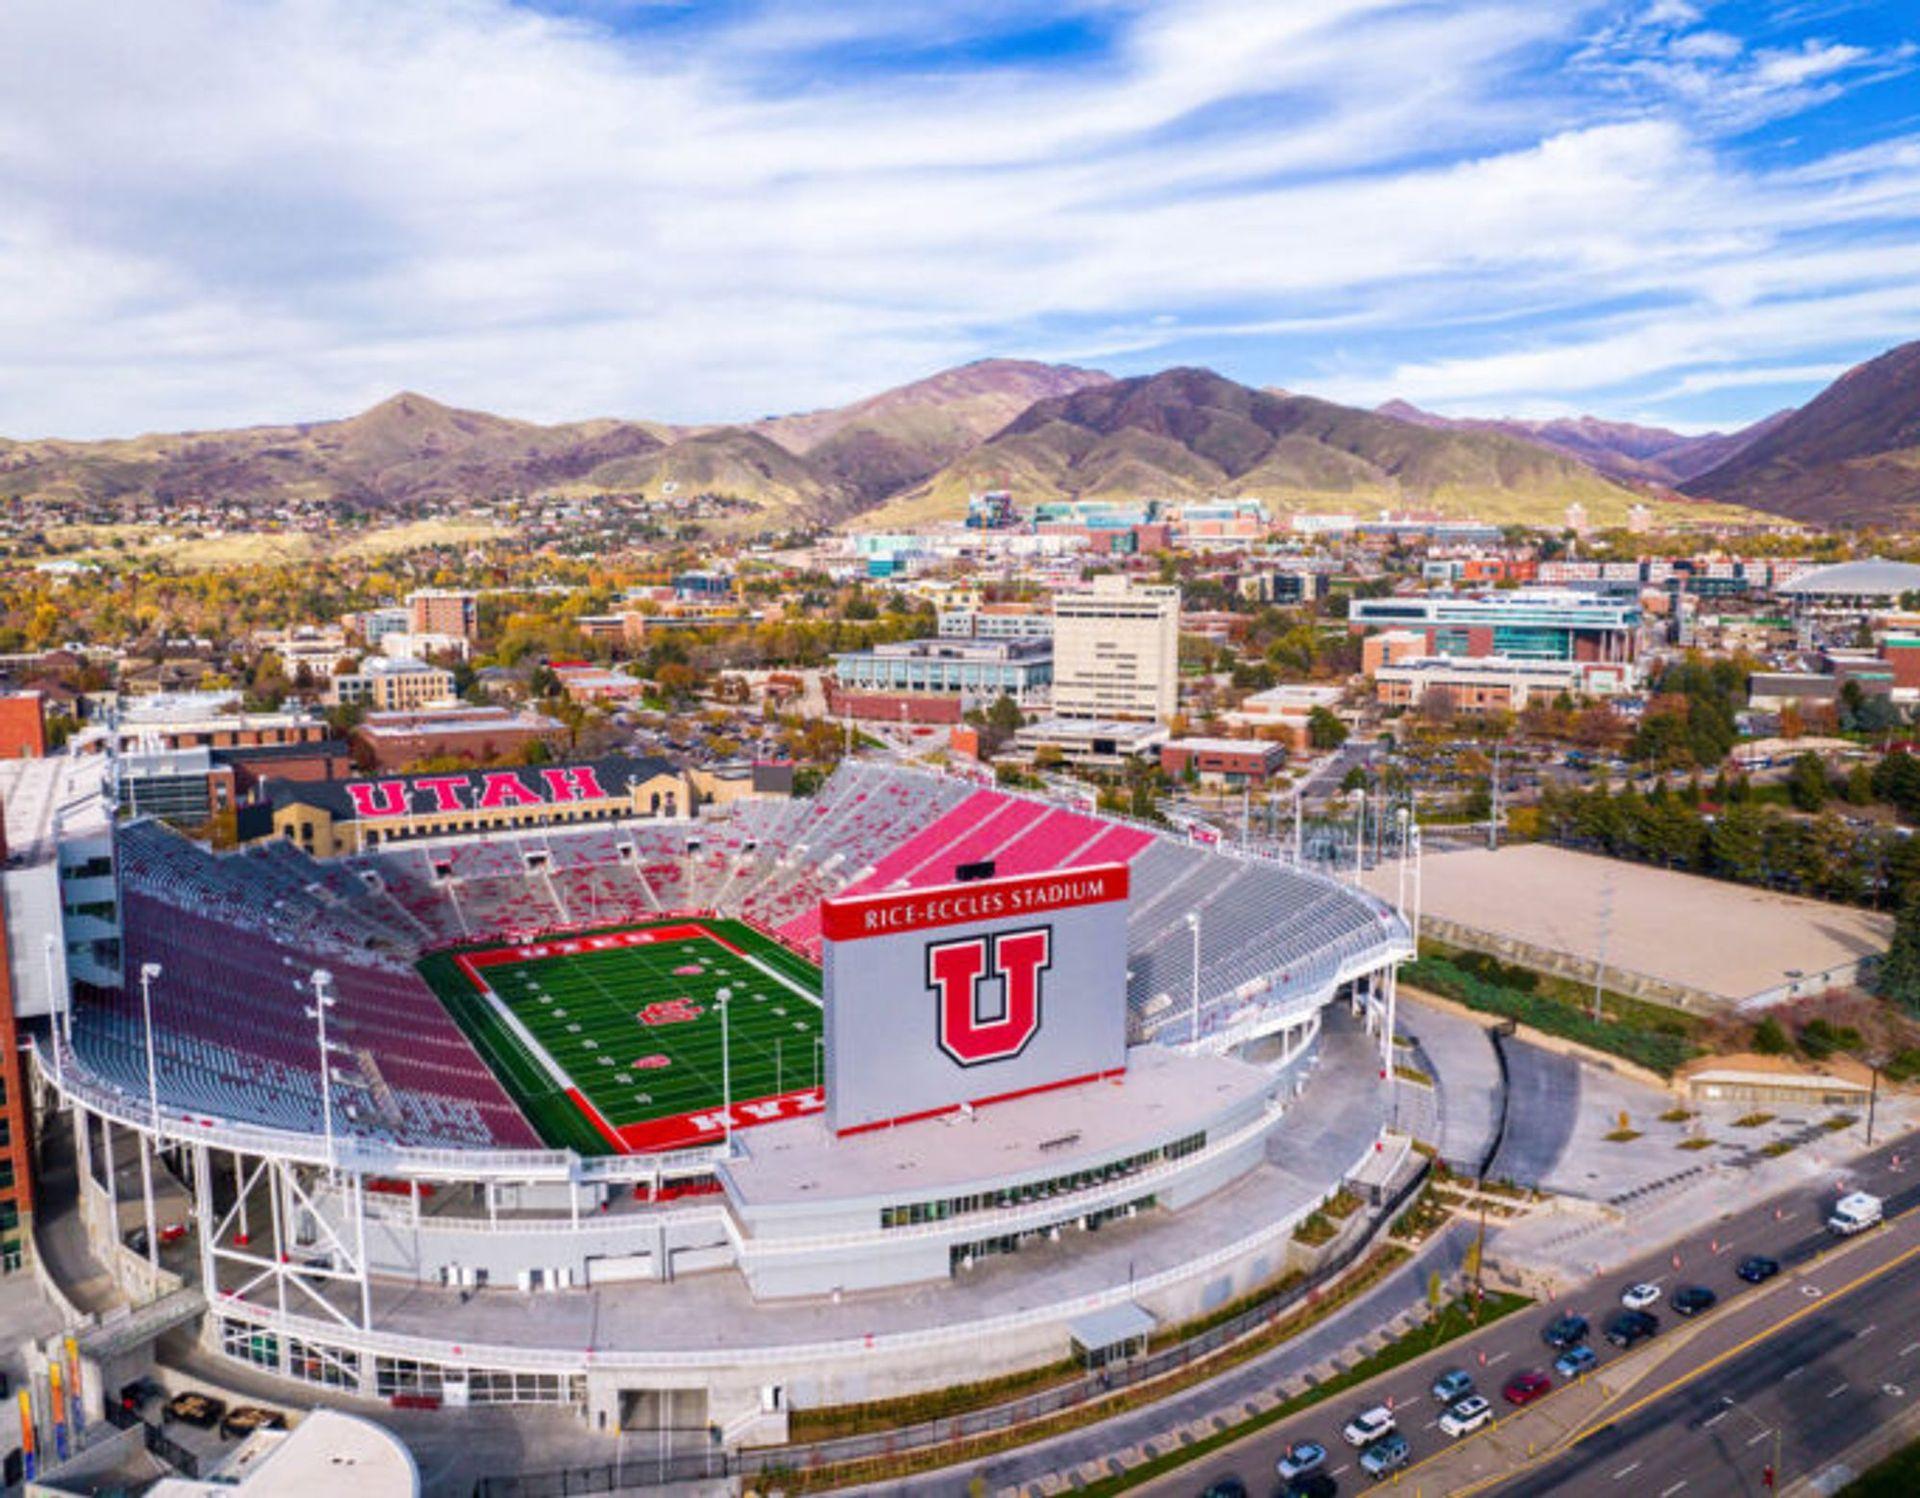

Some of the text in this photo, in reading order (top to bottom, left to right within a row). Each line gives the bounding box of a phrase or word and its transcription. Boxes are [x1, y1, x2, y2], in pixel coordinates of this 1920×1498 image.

[346, 766, 608, 818] UTAH
[864, 878, 1105, 930] RICE-ECCLES STADIUM
[926, 924, 1052, 1068] U
